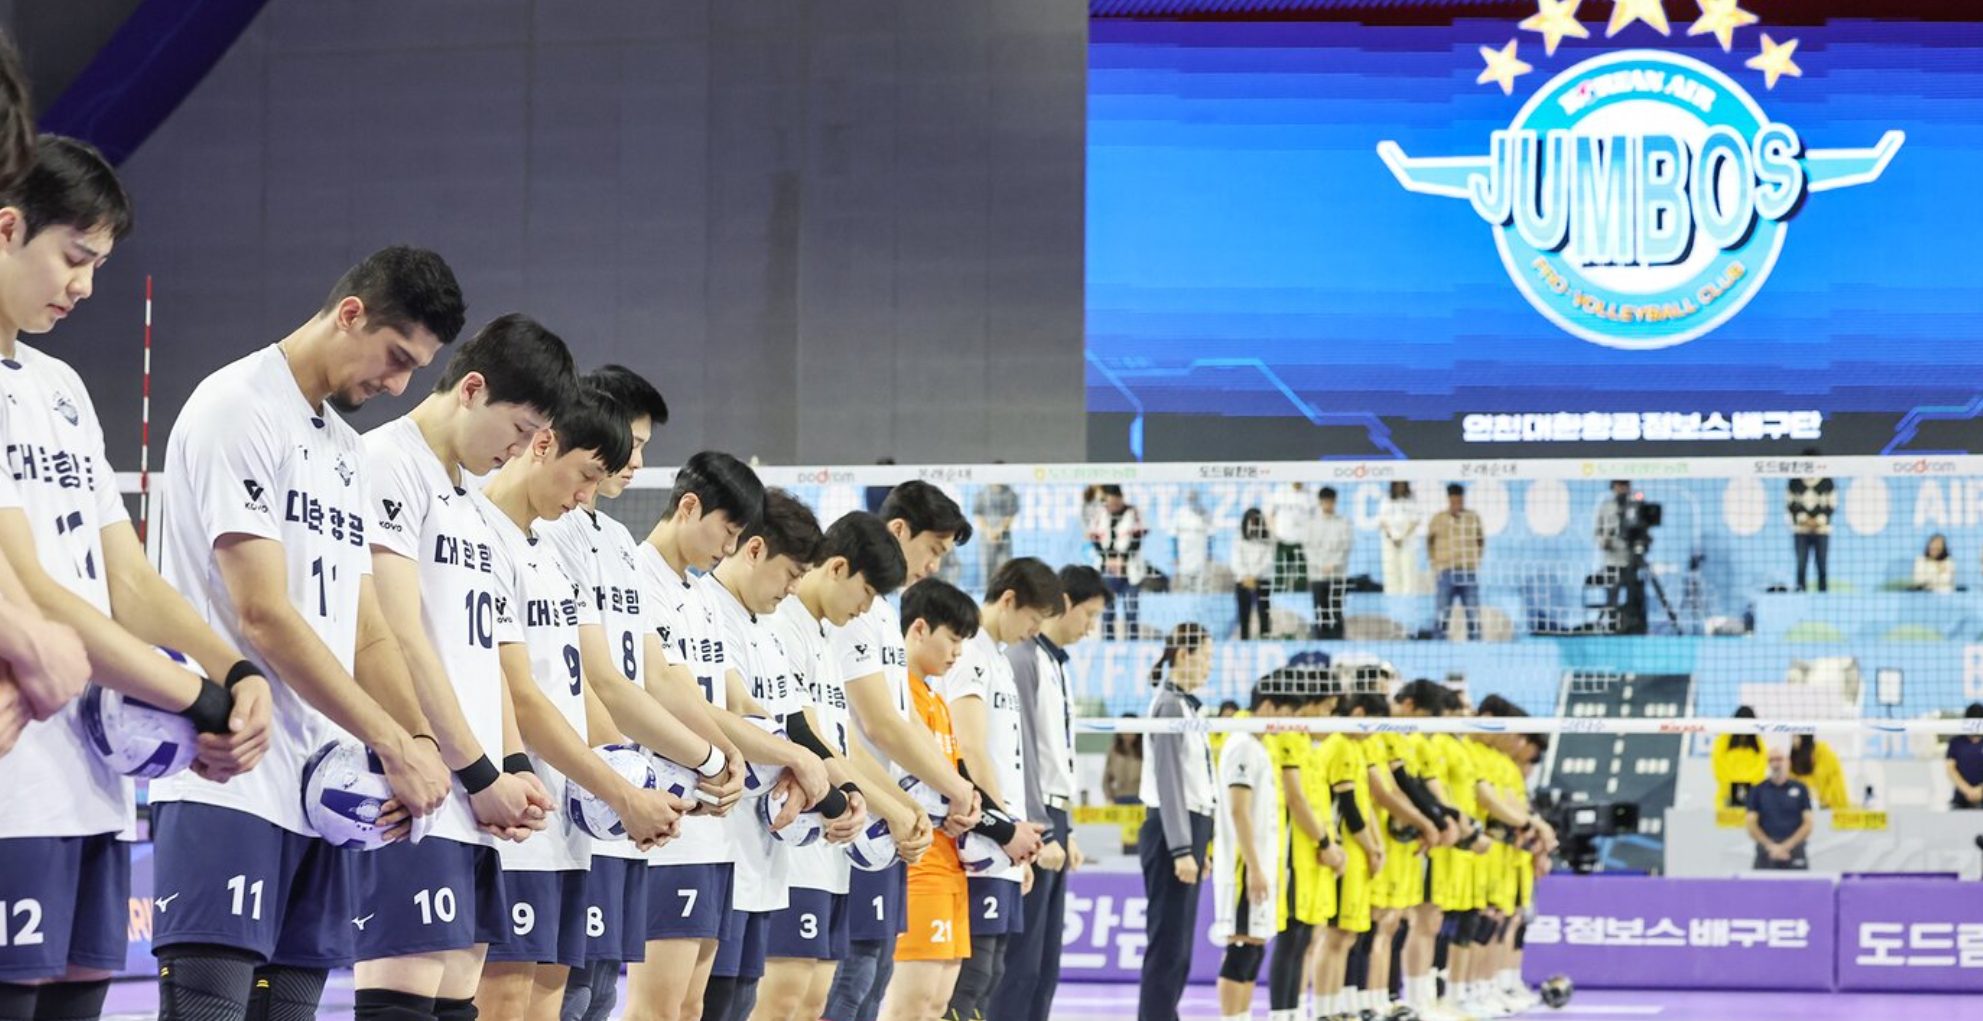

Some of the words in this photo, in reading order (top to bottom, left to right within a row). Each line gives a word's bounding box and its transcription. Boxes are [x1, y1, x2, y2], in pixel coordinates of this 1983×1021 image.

[1467, 123, 1806, 267] JUMBOS
[1573, 288, 1697, 322] VOLLEYBALL
[1697, 261, 1745, 305] CLUB
[465, 588, 494, 649] 10
[563, 644, 582, 697] 9
[622, 630, 637, 681] 8
[227, 874, 264, 921] 11
[413, 886, 457, 925] 10
[677, 888, 698, 918] 7
[872, 896, 885, 921] 1
[983, 896, 999, 920] 2
[512, 902, 536, 936] 9
[586, 905, 606, 938] 8
[800, 913, 819, 939] 3
[930, 918, 954, 943] 21
